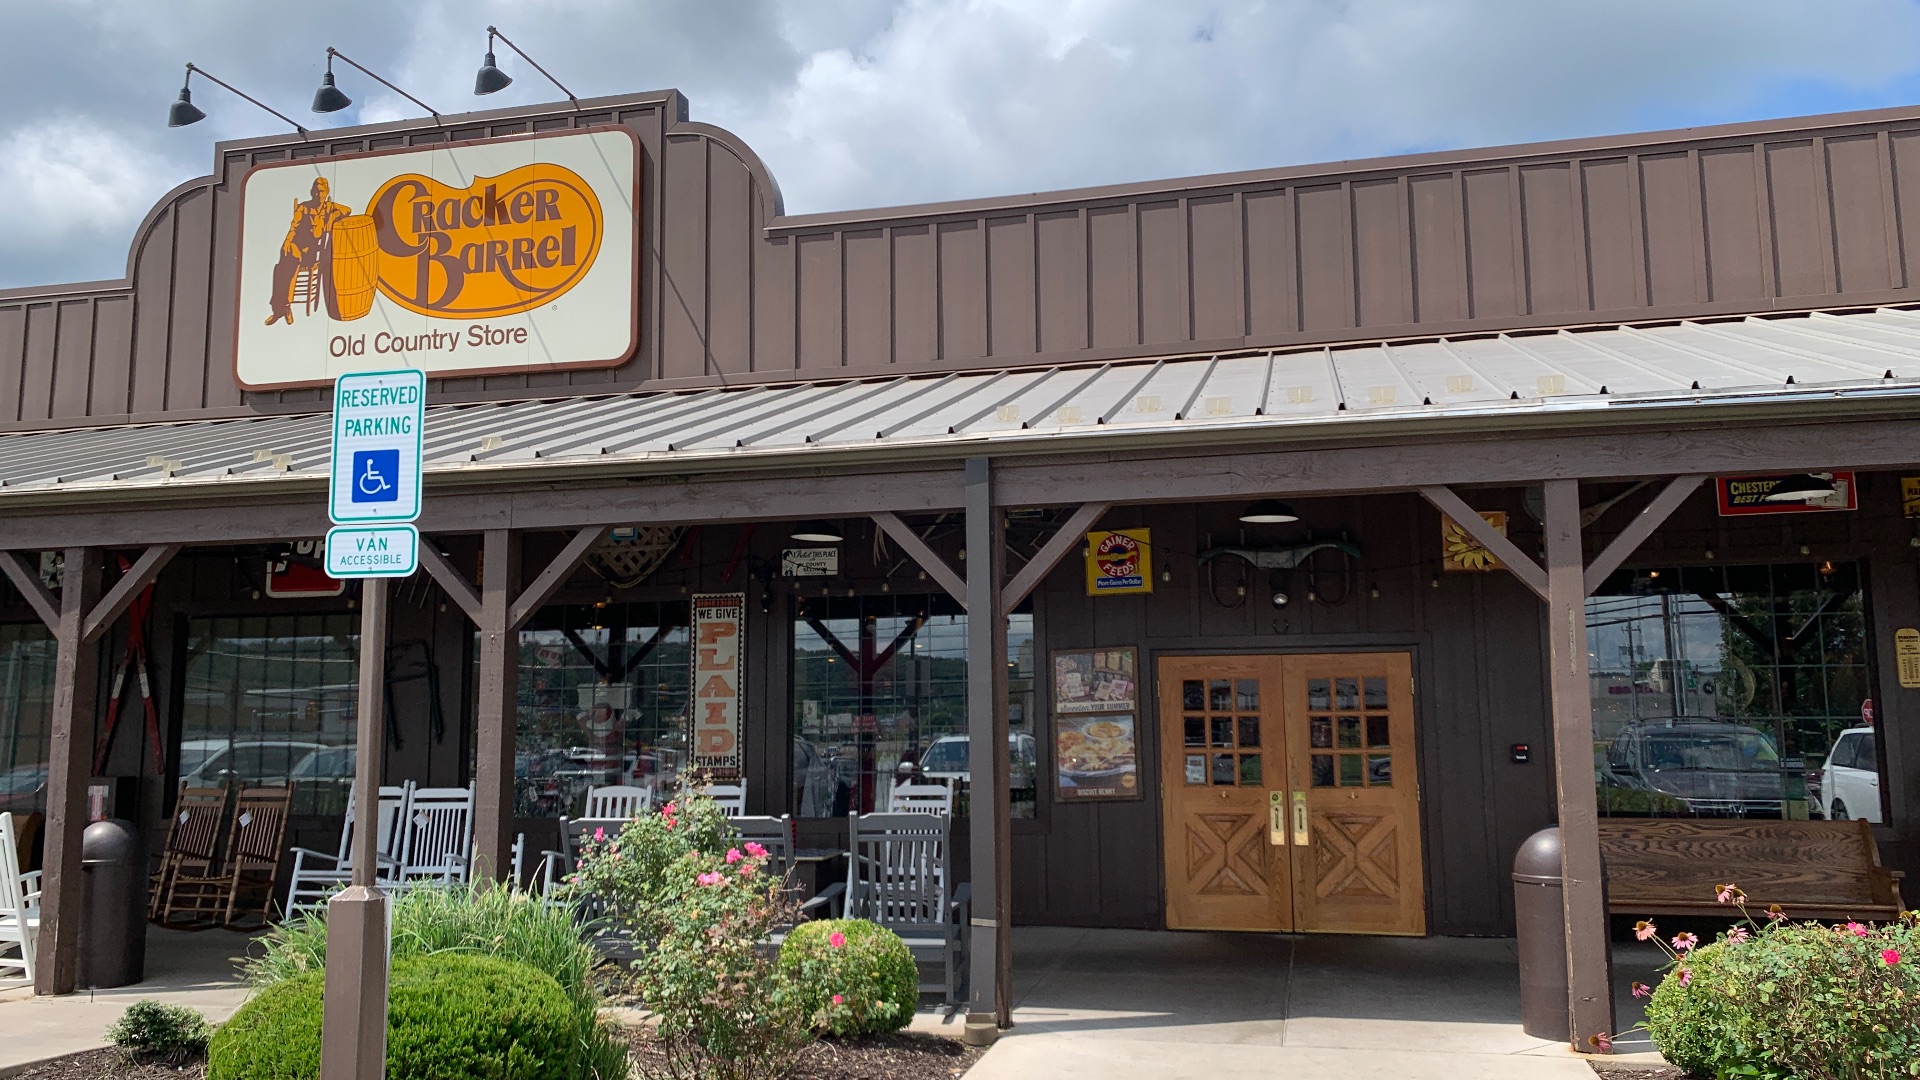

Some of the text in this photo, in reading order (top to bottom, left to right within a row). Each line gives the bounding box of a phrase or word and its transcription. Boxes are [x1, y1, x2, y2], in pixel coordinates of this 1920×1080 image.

[373, 180, 563, 258] Cracker
[413, 225, 577, 309] Barrel
[329, 324, 528, 358] Old Country Store
[341, 386, 418, 408] RESERVED
[344, 415, 411, 438] PARKING
[1733, 494, 1759, 504] BEST
[356, 537, 388, 551] VAN
[1100, 536, 1135, 552] GAINER
[340, 553, 402, 566] ACCESSIBLE
[1104, 562, 1134, 576] FEEDS
[698, 608, 738, 619] WE GIVE
[698, 622, 737, 752] PLAID
[1106, 702, 1130, 710] SUMMER
[695, 755, 736, 767] STAMPS
